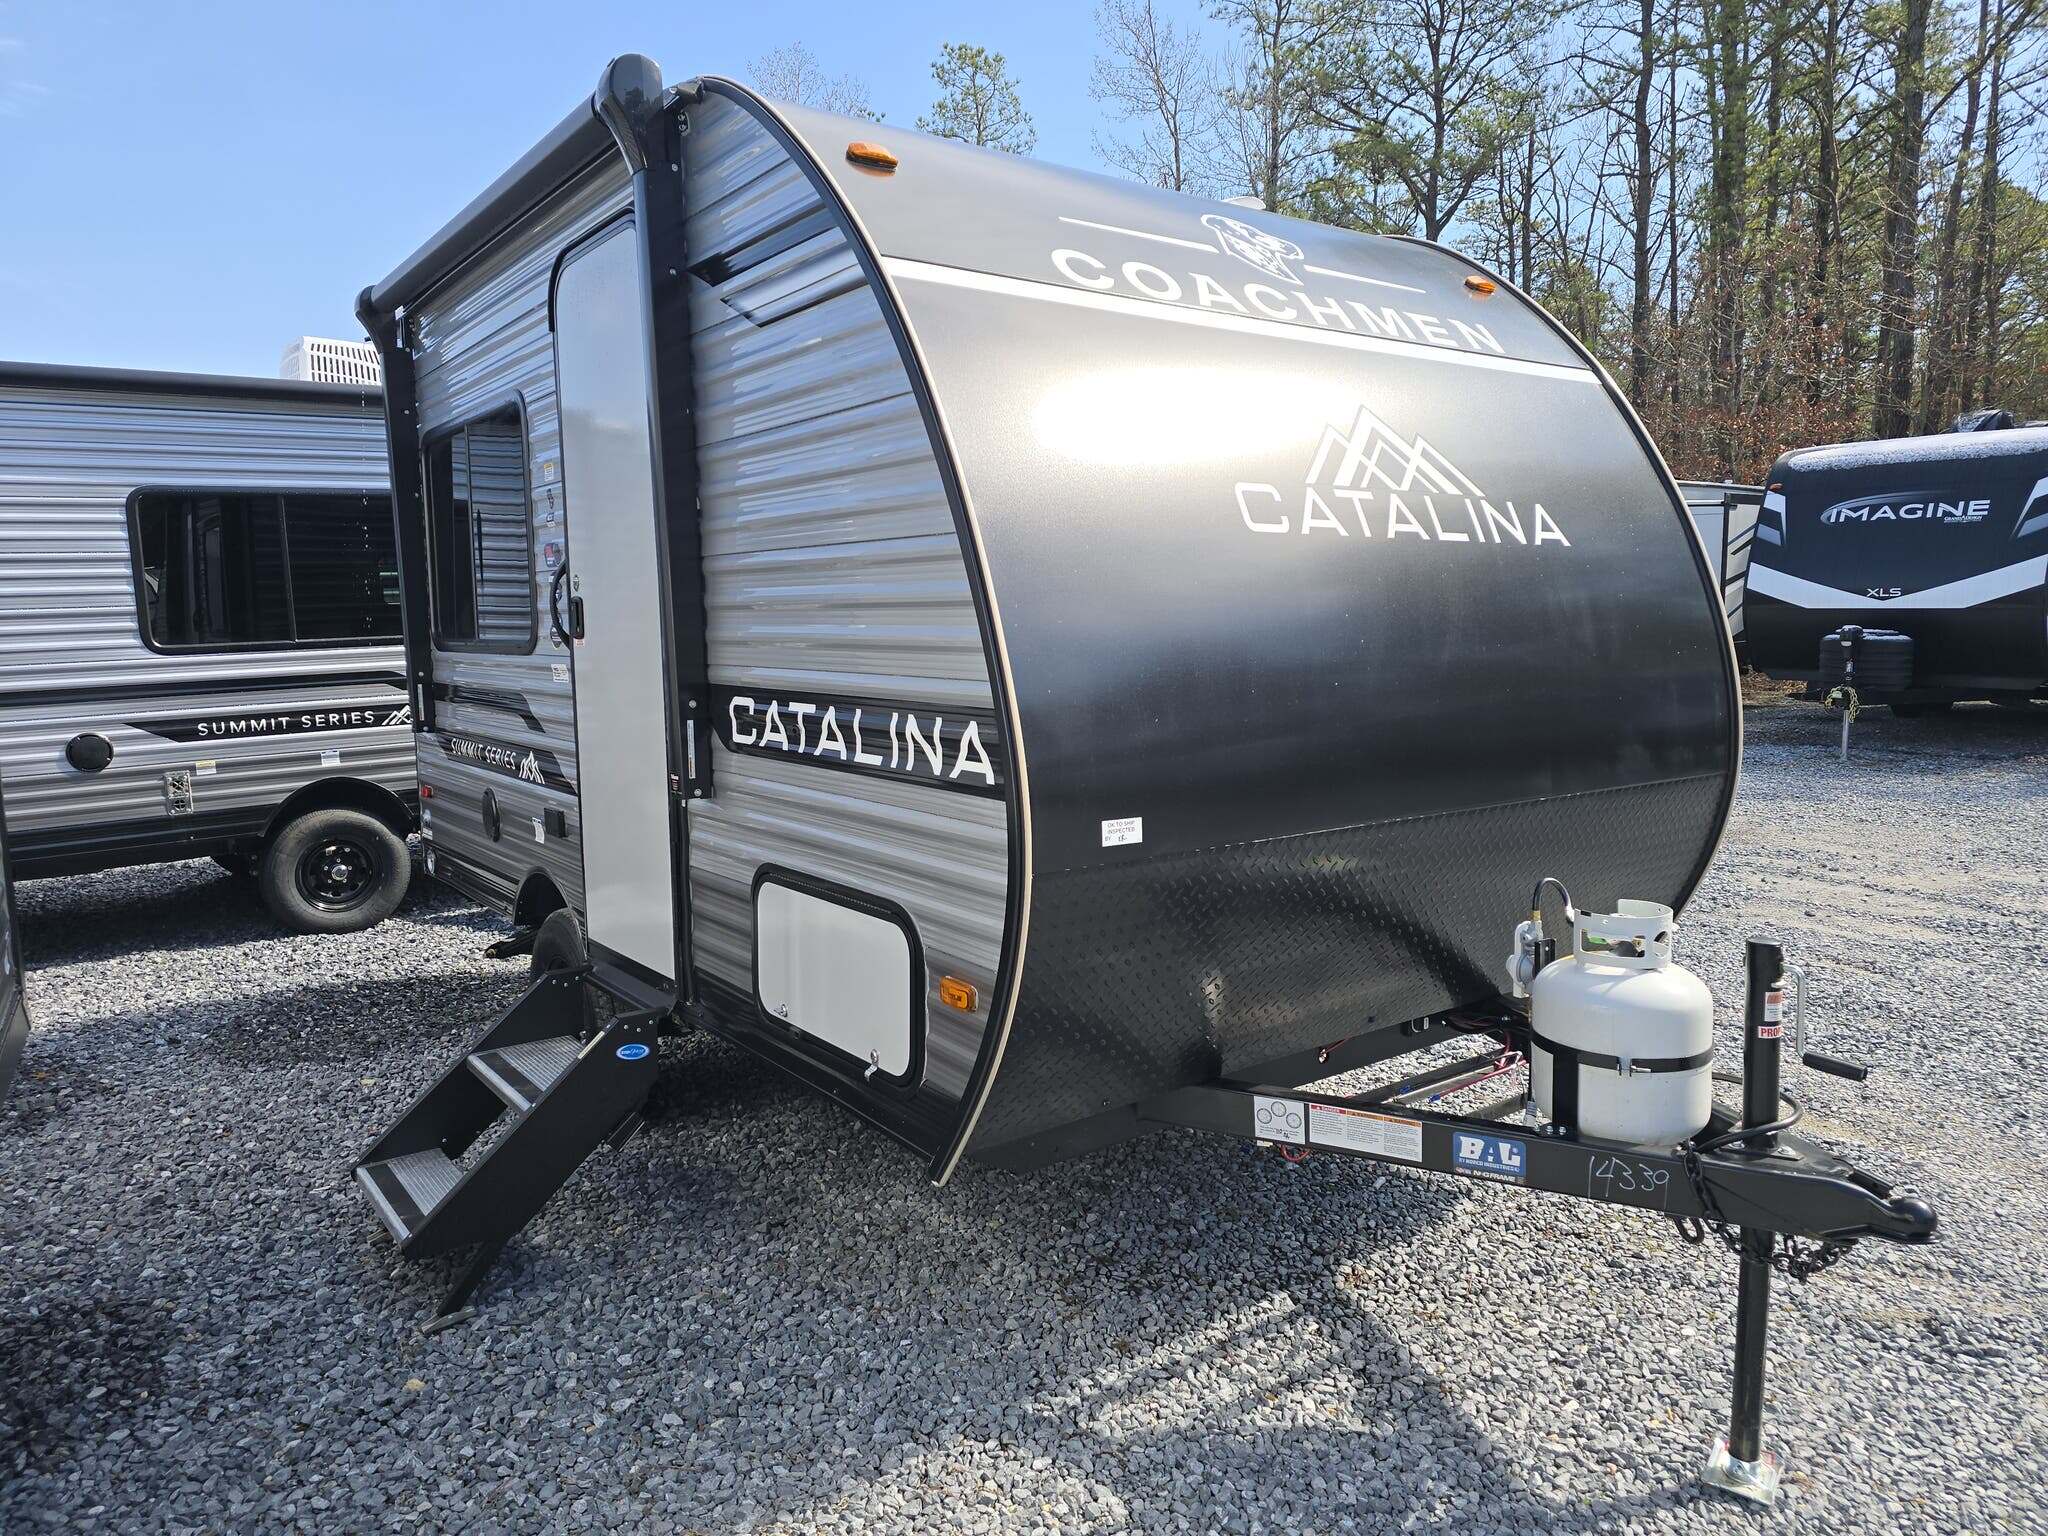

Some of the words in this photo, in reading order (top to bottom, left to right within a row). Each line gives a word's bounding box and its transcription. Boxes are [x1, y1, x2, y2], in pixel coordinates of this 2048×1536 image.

[1051, 248, 1506, 354] COACHMEN
[1234, 481, 1572, 547] CATALINA
[1829, 499, 1991, 523] IMAGINE
[1866, 587, 1902, 597] XLS
[197, 716, 290, 736] SUMMIT
[301, 710, 375, 728] SERIES
[728, 695, 996, 786] CATALINA
[450, 737, 484, 760] SUMMIT
[485, 745, 517, 770] SERIES
[1587, 1155, 1670, 1210] 14339
